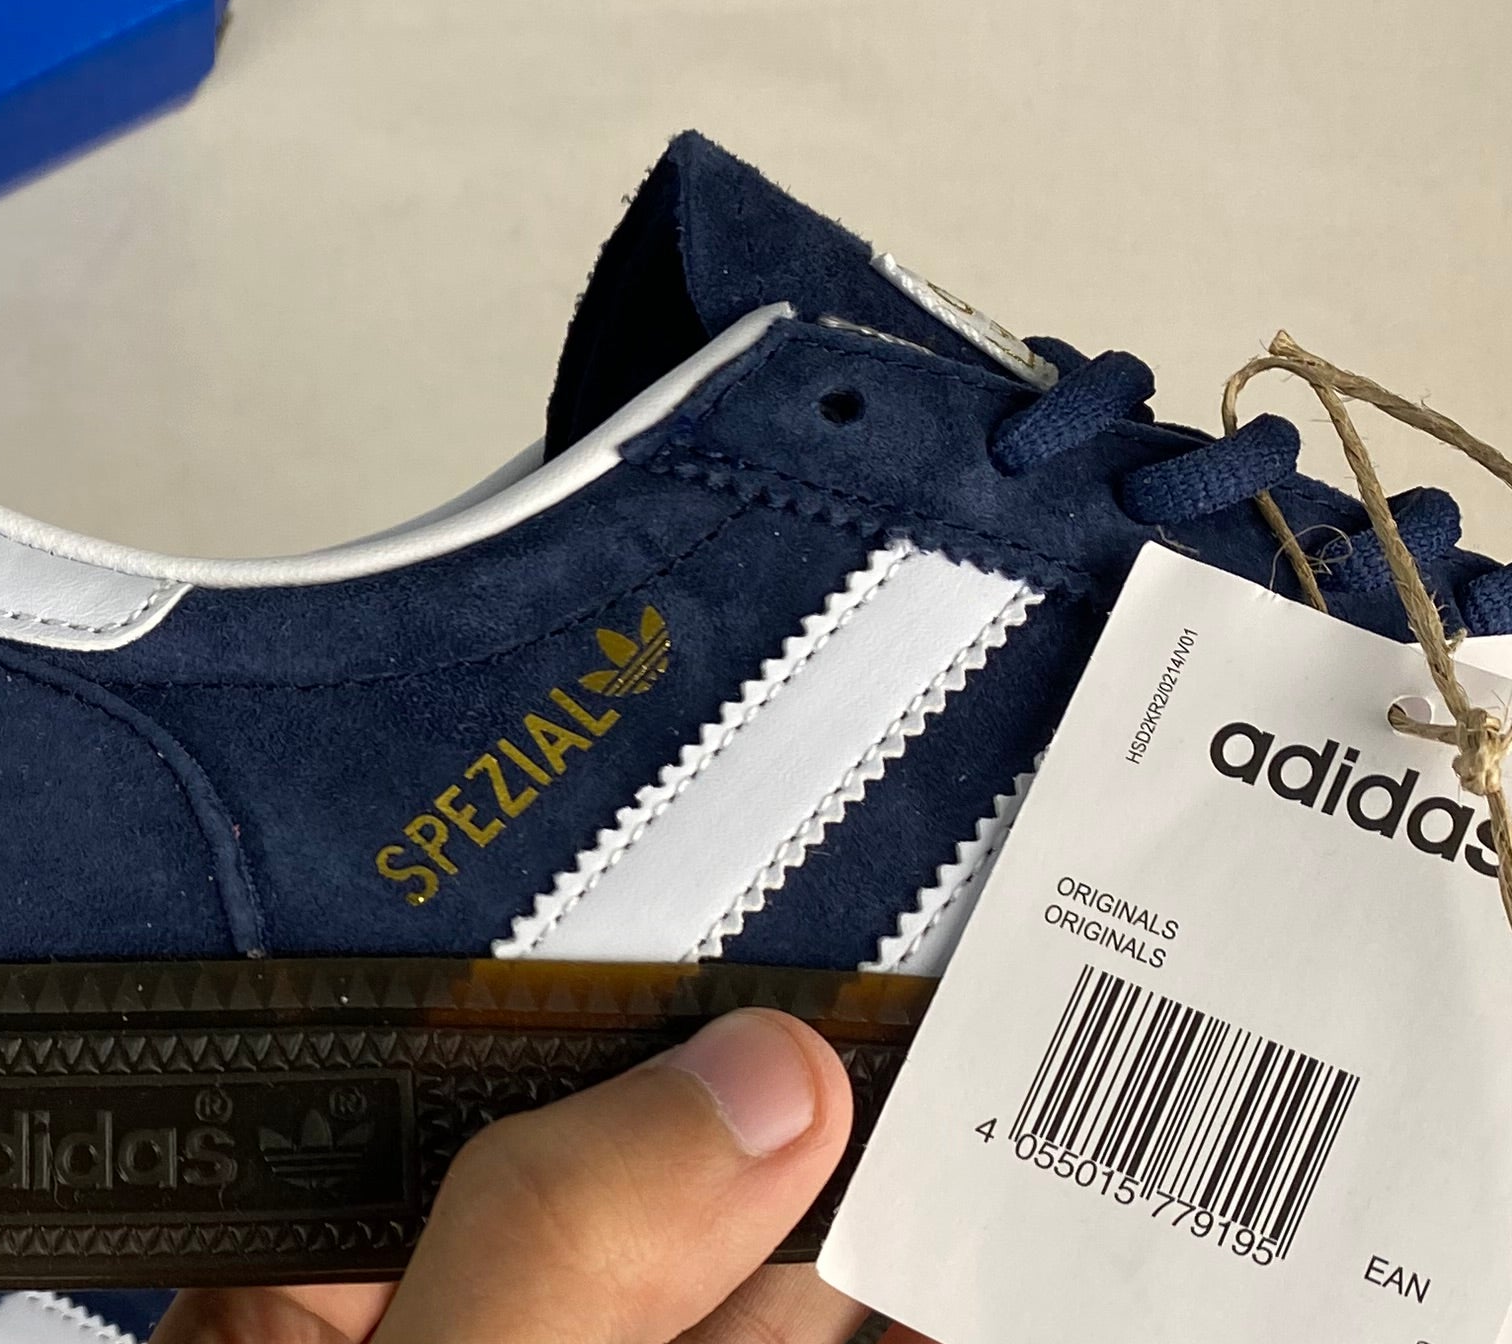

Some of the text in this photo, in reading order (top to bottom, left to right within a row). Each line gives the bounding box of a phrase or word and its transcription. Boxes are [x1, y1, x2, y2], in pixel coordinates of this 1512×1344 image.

[375, 686, 622, 906] SPEZIAL
[1208, 721, 1500, 879] adidas
[1043, 903, 1167, 970] ORIGINALS
[1055, 875, 1180, 942] ORIGINALS
[974, 1117, 1279, 1268] 4 055015 779195
[1364, 1254, 1431, 1304] EAN
